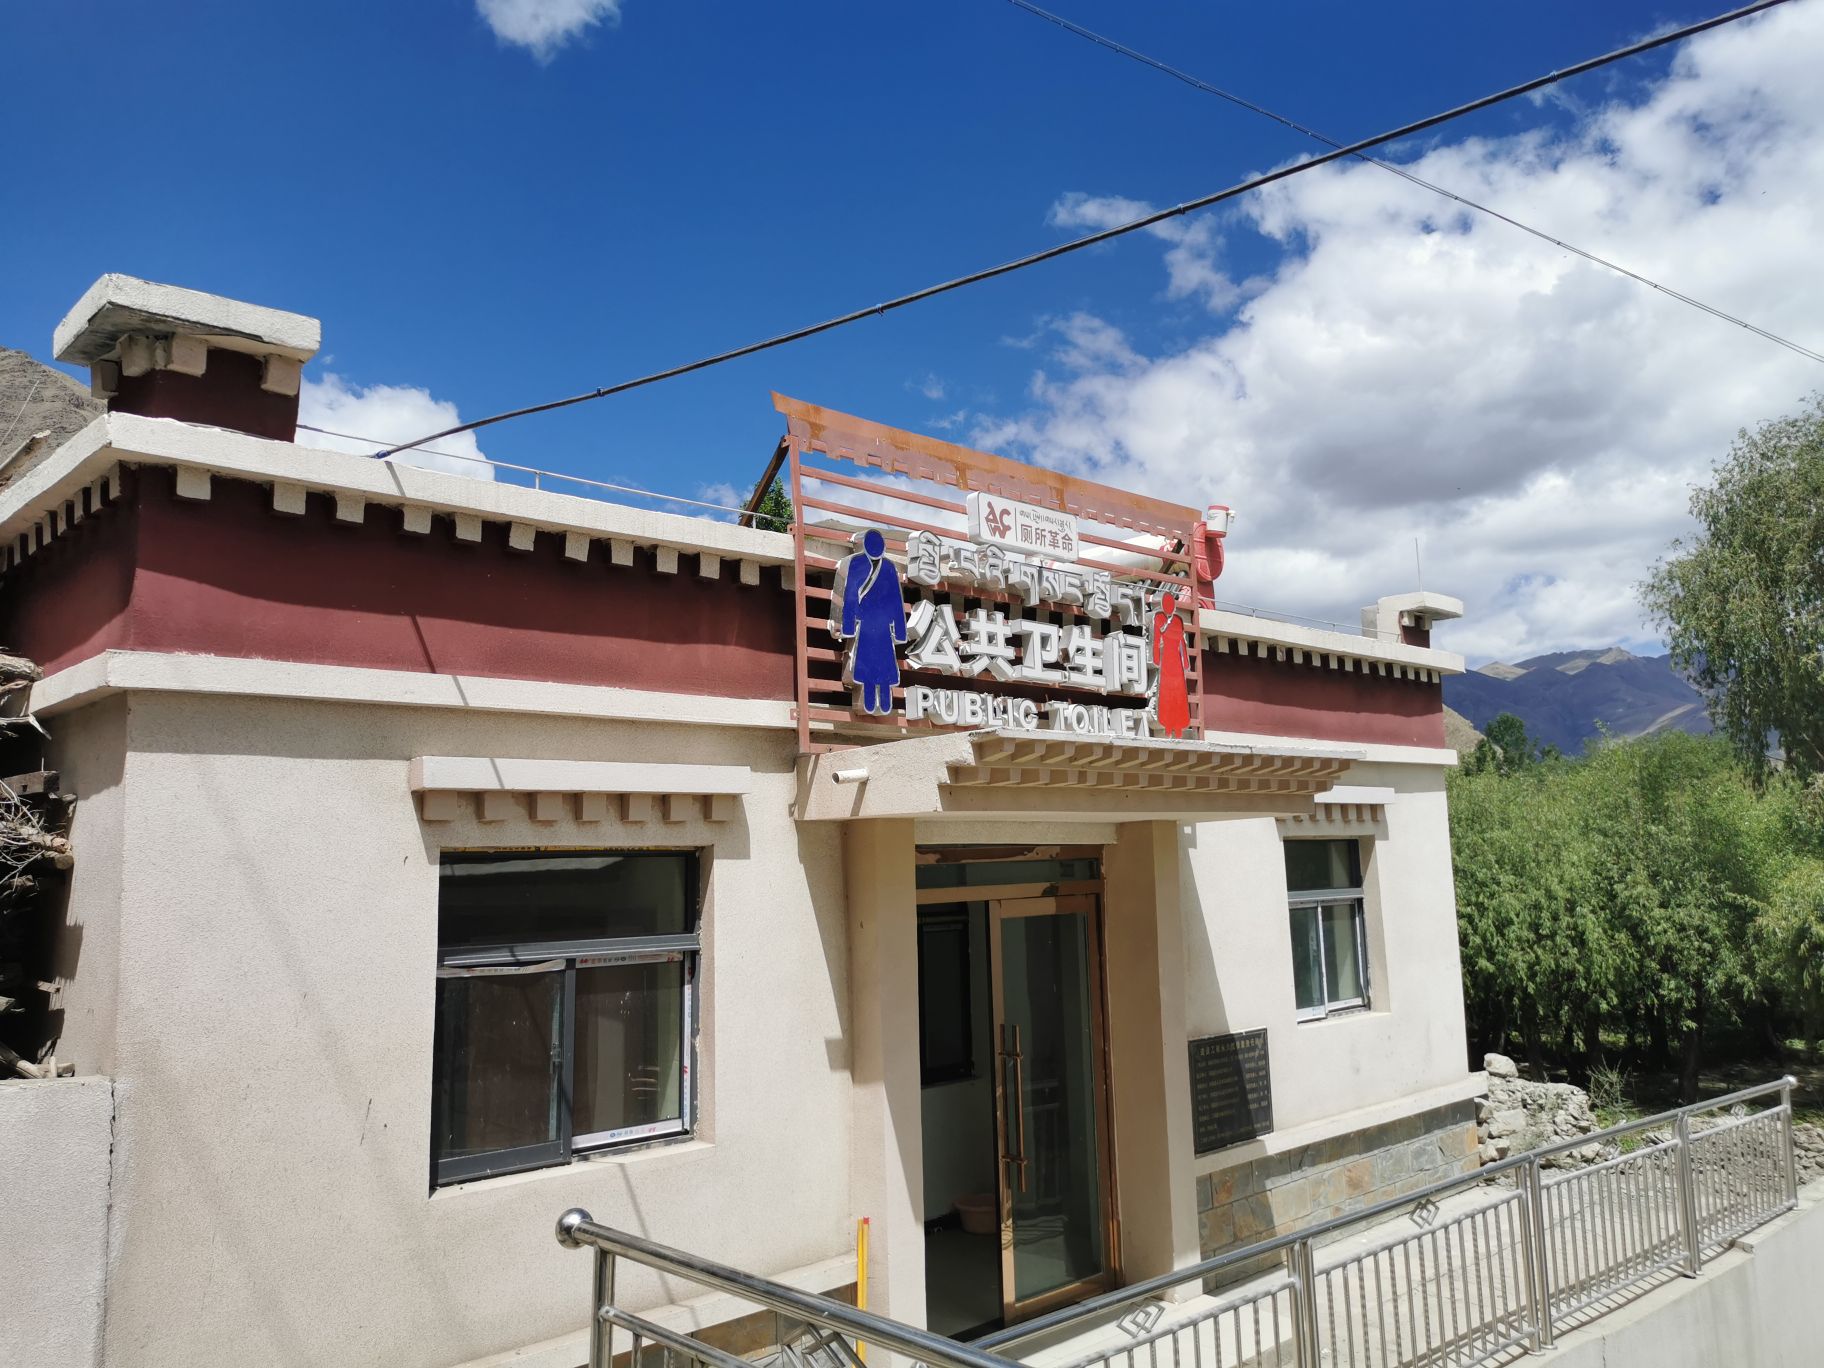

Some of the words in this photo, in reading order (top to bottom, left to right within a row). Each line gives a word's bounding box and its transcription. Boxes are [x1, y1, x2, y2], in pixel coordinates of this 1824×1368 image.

[1020, 523, 1073, 554] 厕所革命
[906, 599, 1147, 693] 公共卫生间
[907, 684, 1038, 729] PUBLIC
[1047, 700, 1151, 738] TOILET
